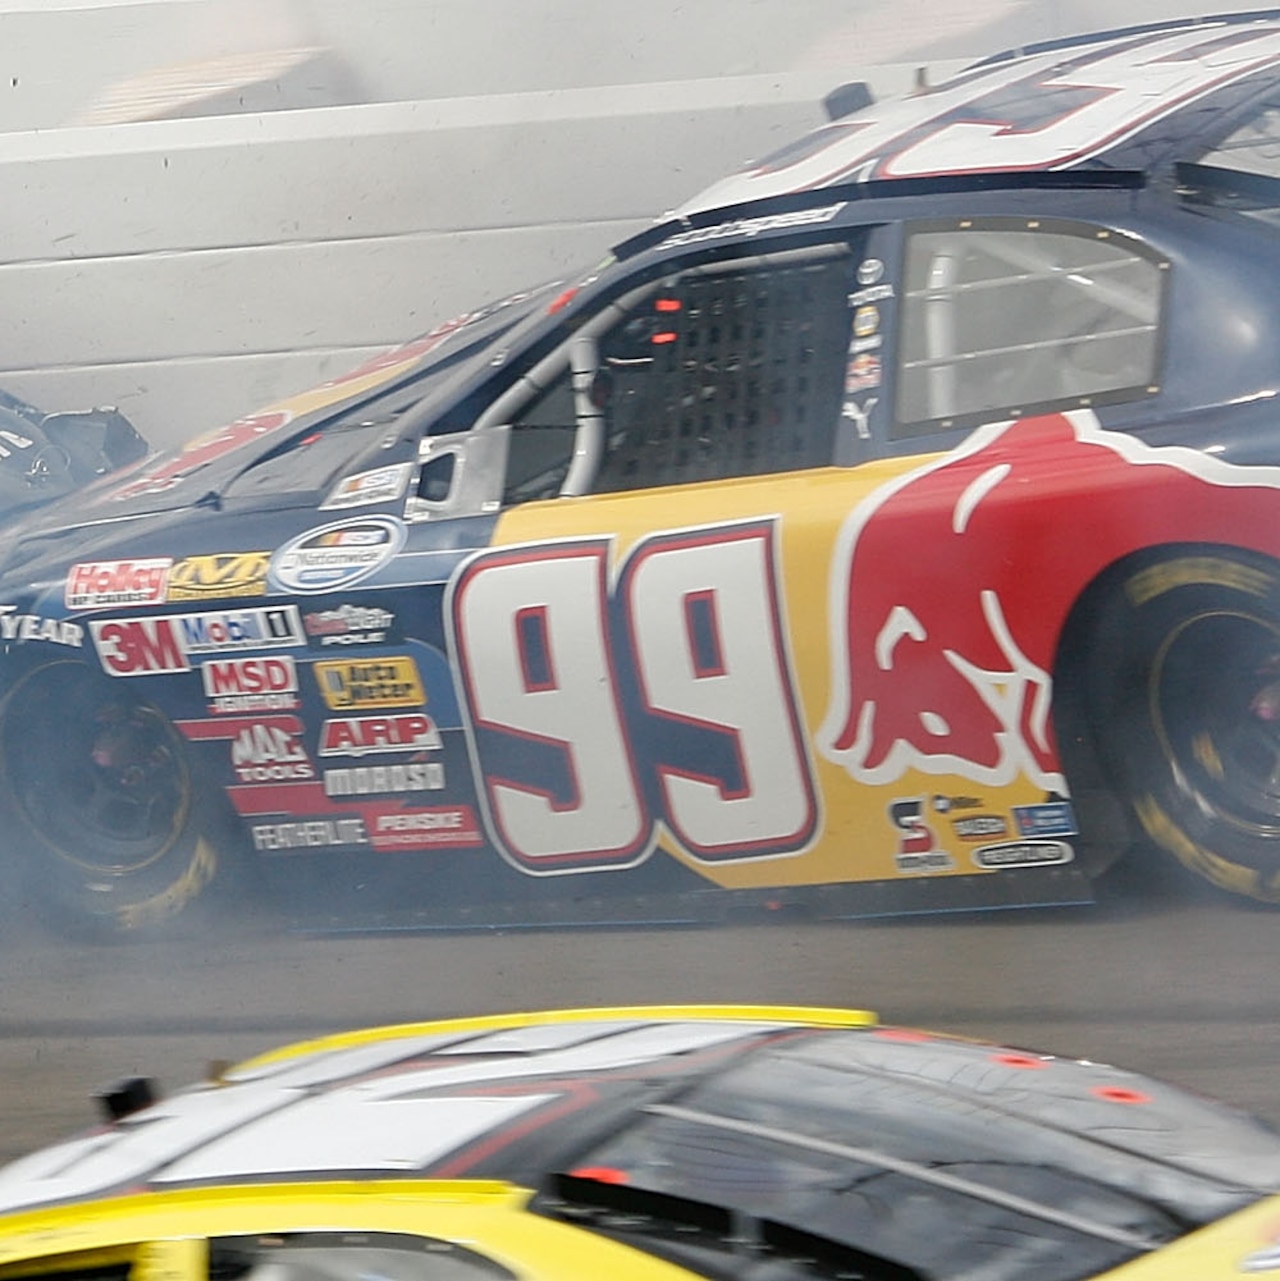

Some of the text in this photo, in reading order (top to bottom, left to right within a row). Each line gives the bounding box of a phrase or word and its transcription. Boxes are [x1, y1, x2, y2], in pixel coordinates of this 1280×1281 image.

[100, 620, 184, 673] 3M
[321, 632, 386, 645] POLE
[210, 659, 290, 694] MSD
[444, 515, 822, 877] 99
[324, 717, 429, 749] ARP
[235, 764, 315, 781] TOOLS
